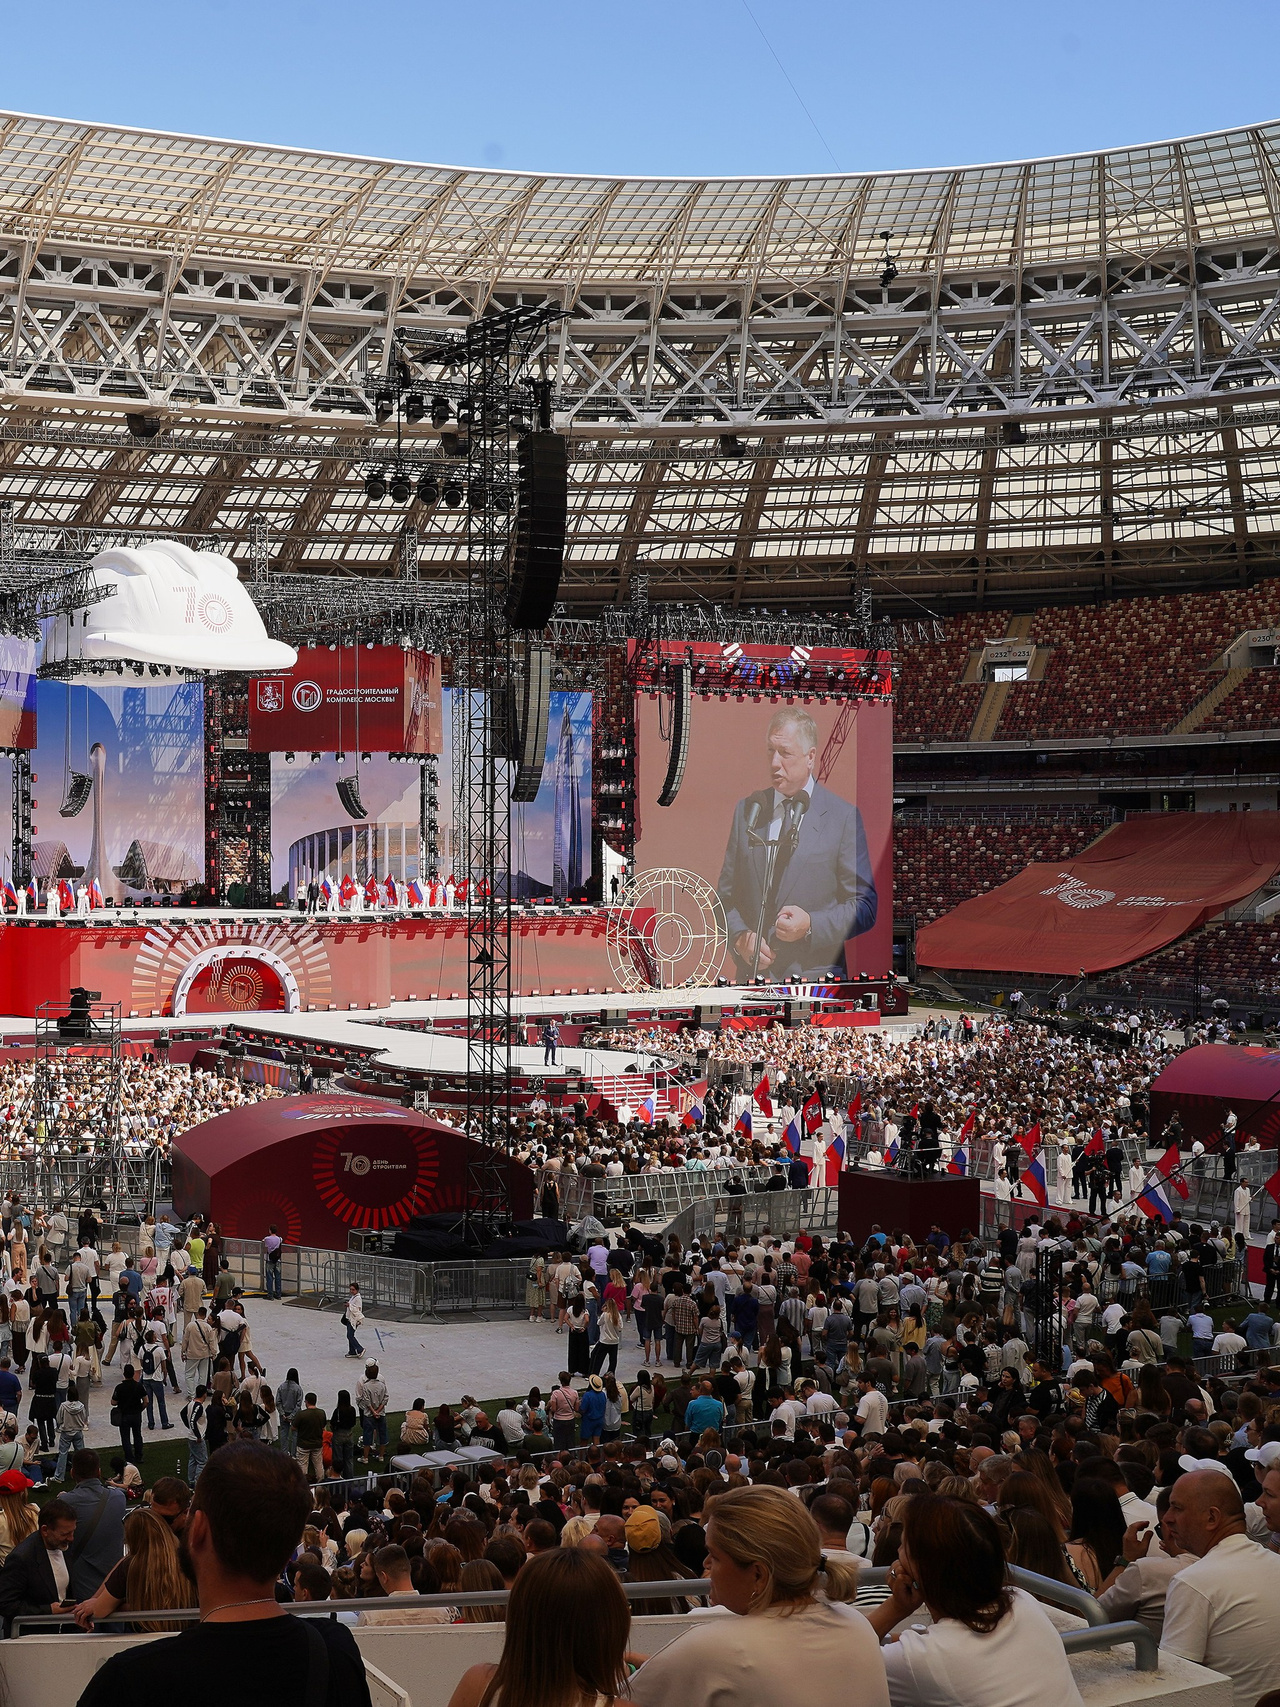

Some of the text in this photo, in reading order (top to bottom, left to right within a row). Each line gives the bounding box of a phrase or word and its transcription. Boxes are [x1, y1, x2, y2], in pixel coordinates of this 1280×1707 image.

[326, 686, 399, 695] ГРАДОСТРОИТЕЛЬНЫЙ
[340, 1152, 371, 1176] 70
[156, 1294, 168, 1306] 12
